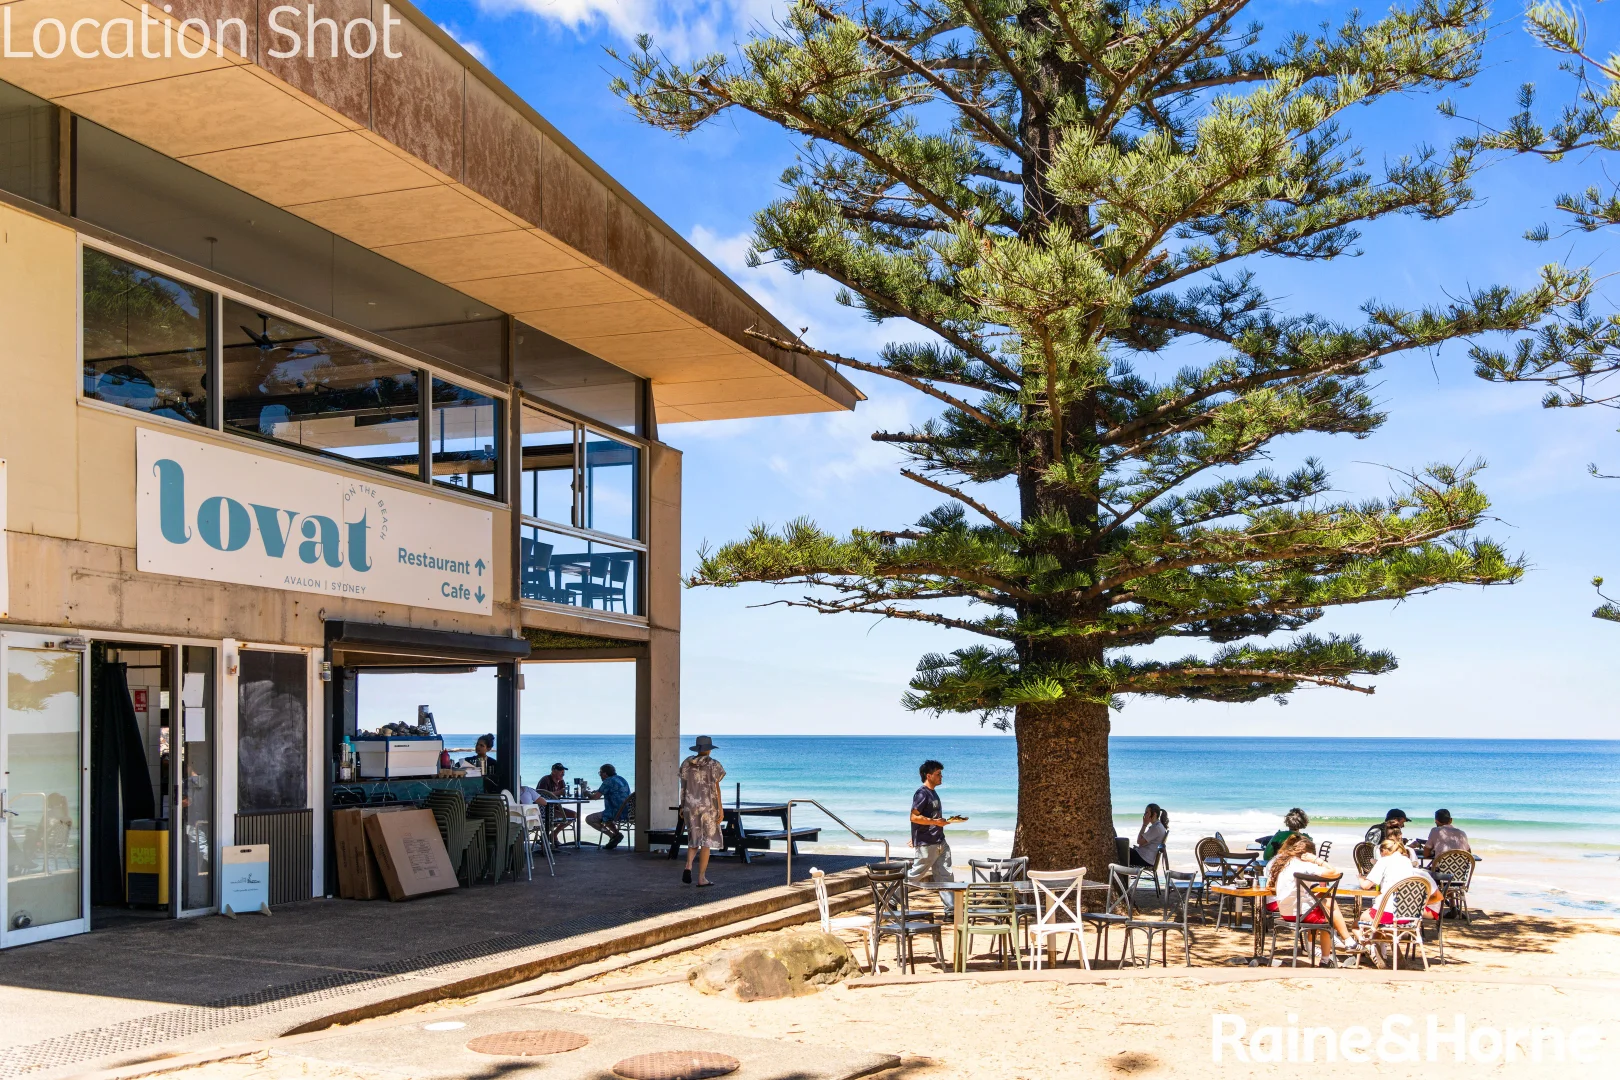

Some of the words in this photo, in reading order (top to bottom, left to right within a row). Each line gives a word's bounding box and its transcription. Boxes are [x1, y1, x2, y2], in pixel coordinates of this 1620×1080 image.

[152, 458, 372, 573] lovat
[344, 485, 356, 501] ON
[359, 484, 377, 498] THE
[377, 500, 388, 540] BEACH
[398, 547, 470, 575] Restaurant
[284, 575, 321, 589] AVALON
[331, 582, 366, 594] SYDNEY
[441, 582, 471, 600] Cafe
[130, 847, 156, 856] PURE
